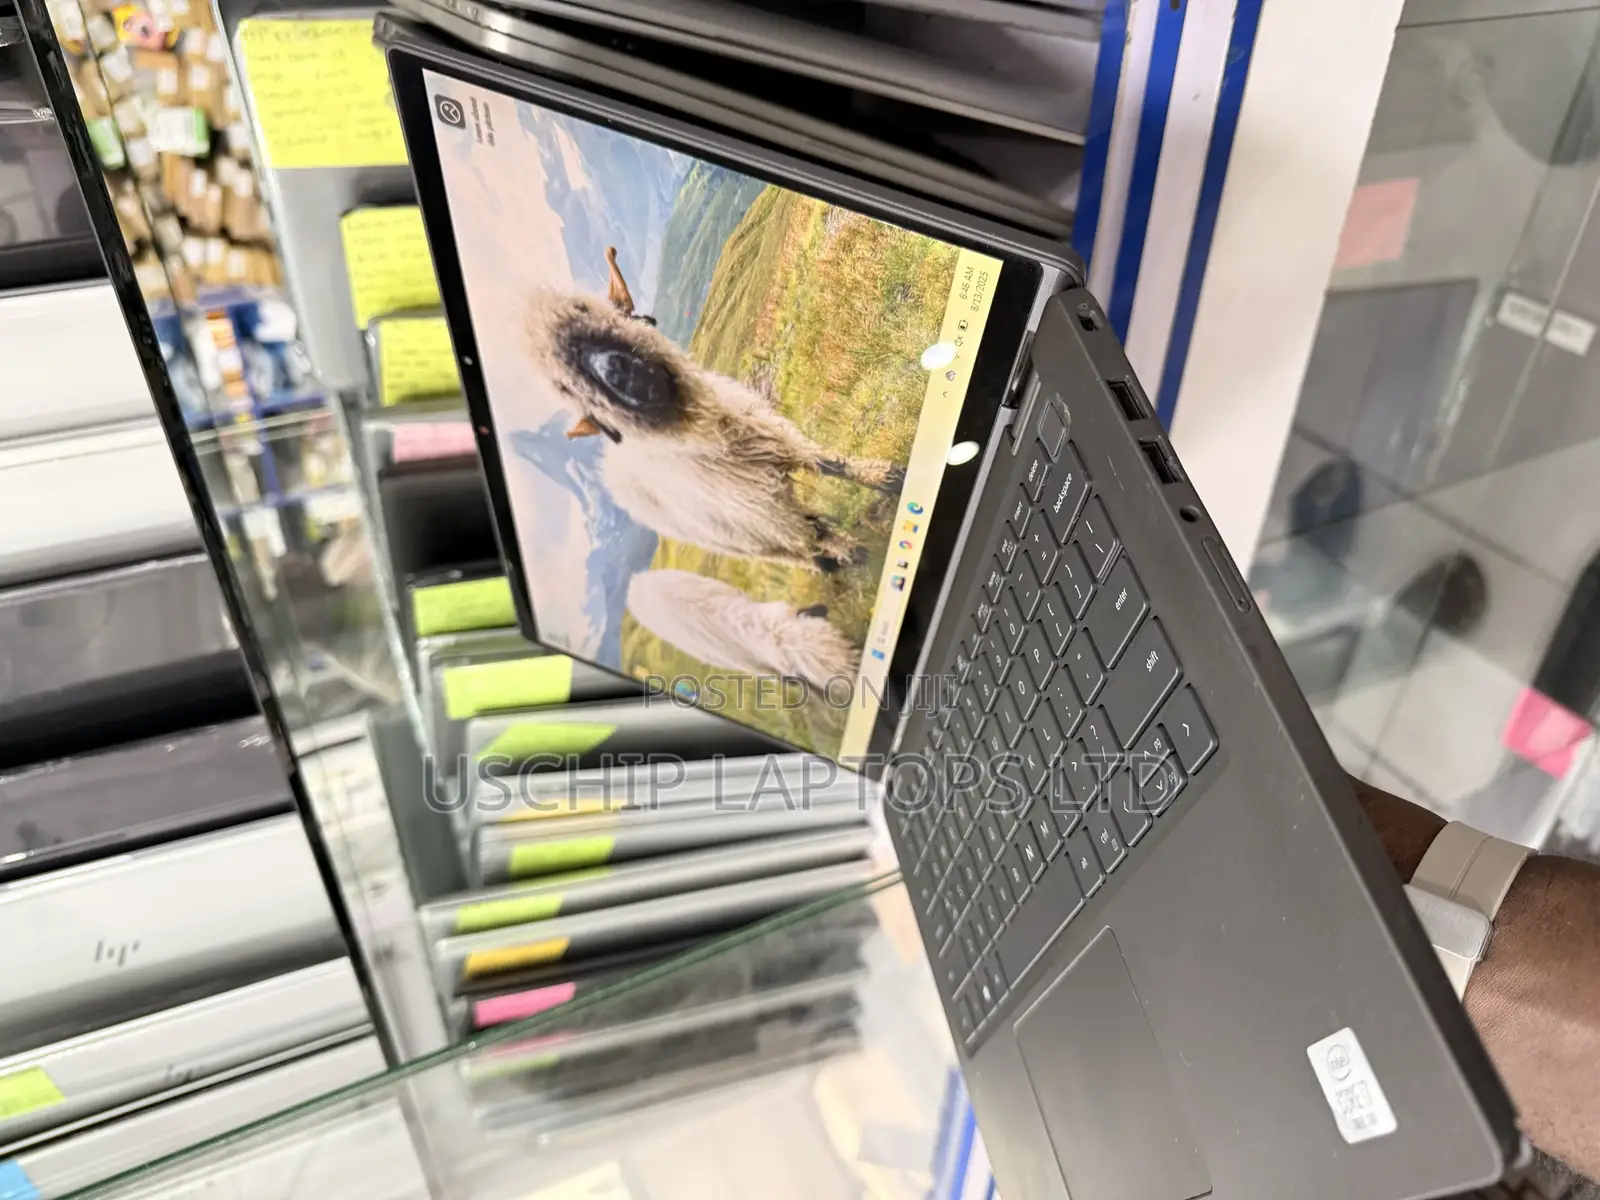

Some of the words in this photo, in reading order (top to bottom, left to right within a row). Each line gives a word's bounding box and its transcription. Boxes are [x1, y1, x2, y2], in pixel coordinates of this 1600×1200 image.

[964, 266, 974, 282] AM
[959, 282, 970, 300] 6:46
[970, 271, 989, 312] 8/13/2025
[1028, 459, 1039, 482] delete
[1052, 472, 1072, 514] backspace
[1013, 501, 1022, 521] insert
[1115, 587, 1128, 611] enter
[1034, 648, 1040, 664] P
[1146, 650, 1159, 672] shift
[1018, 680, 1025, 695] O
[1042, 728, 1050, 741] L
[1090, 725, 1098, 740] ?
[1027, 754, 1035, 770] K
[1025, 844, 1035, 862] N
